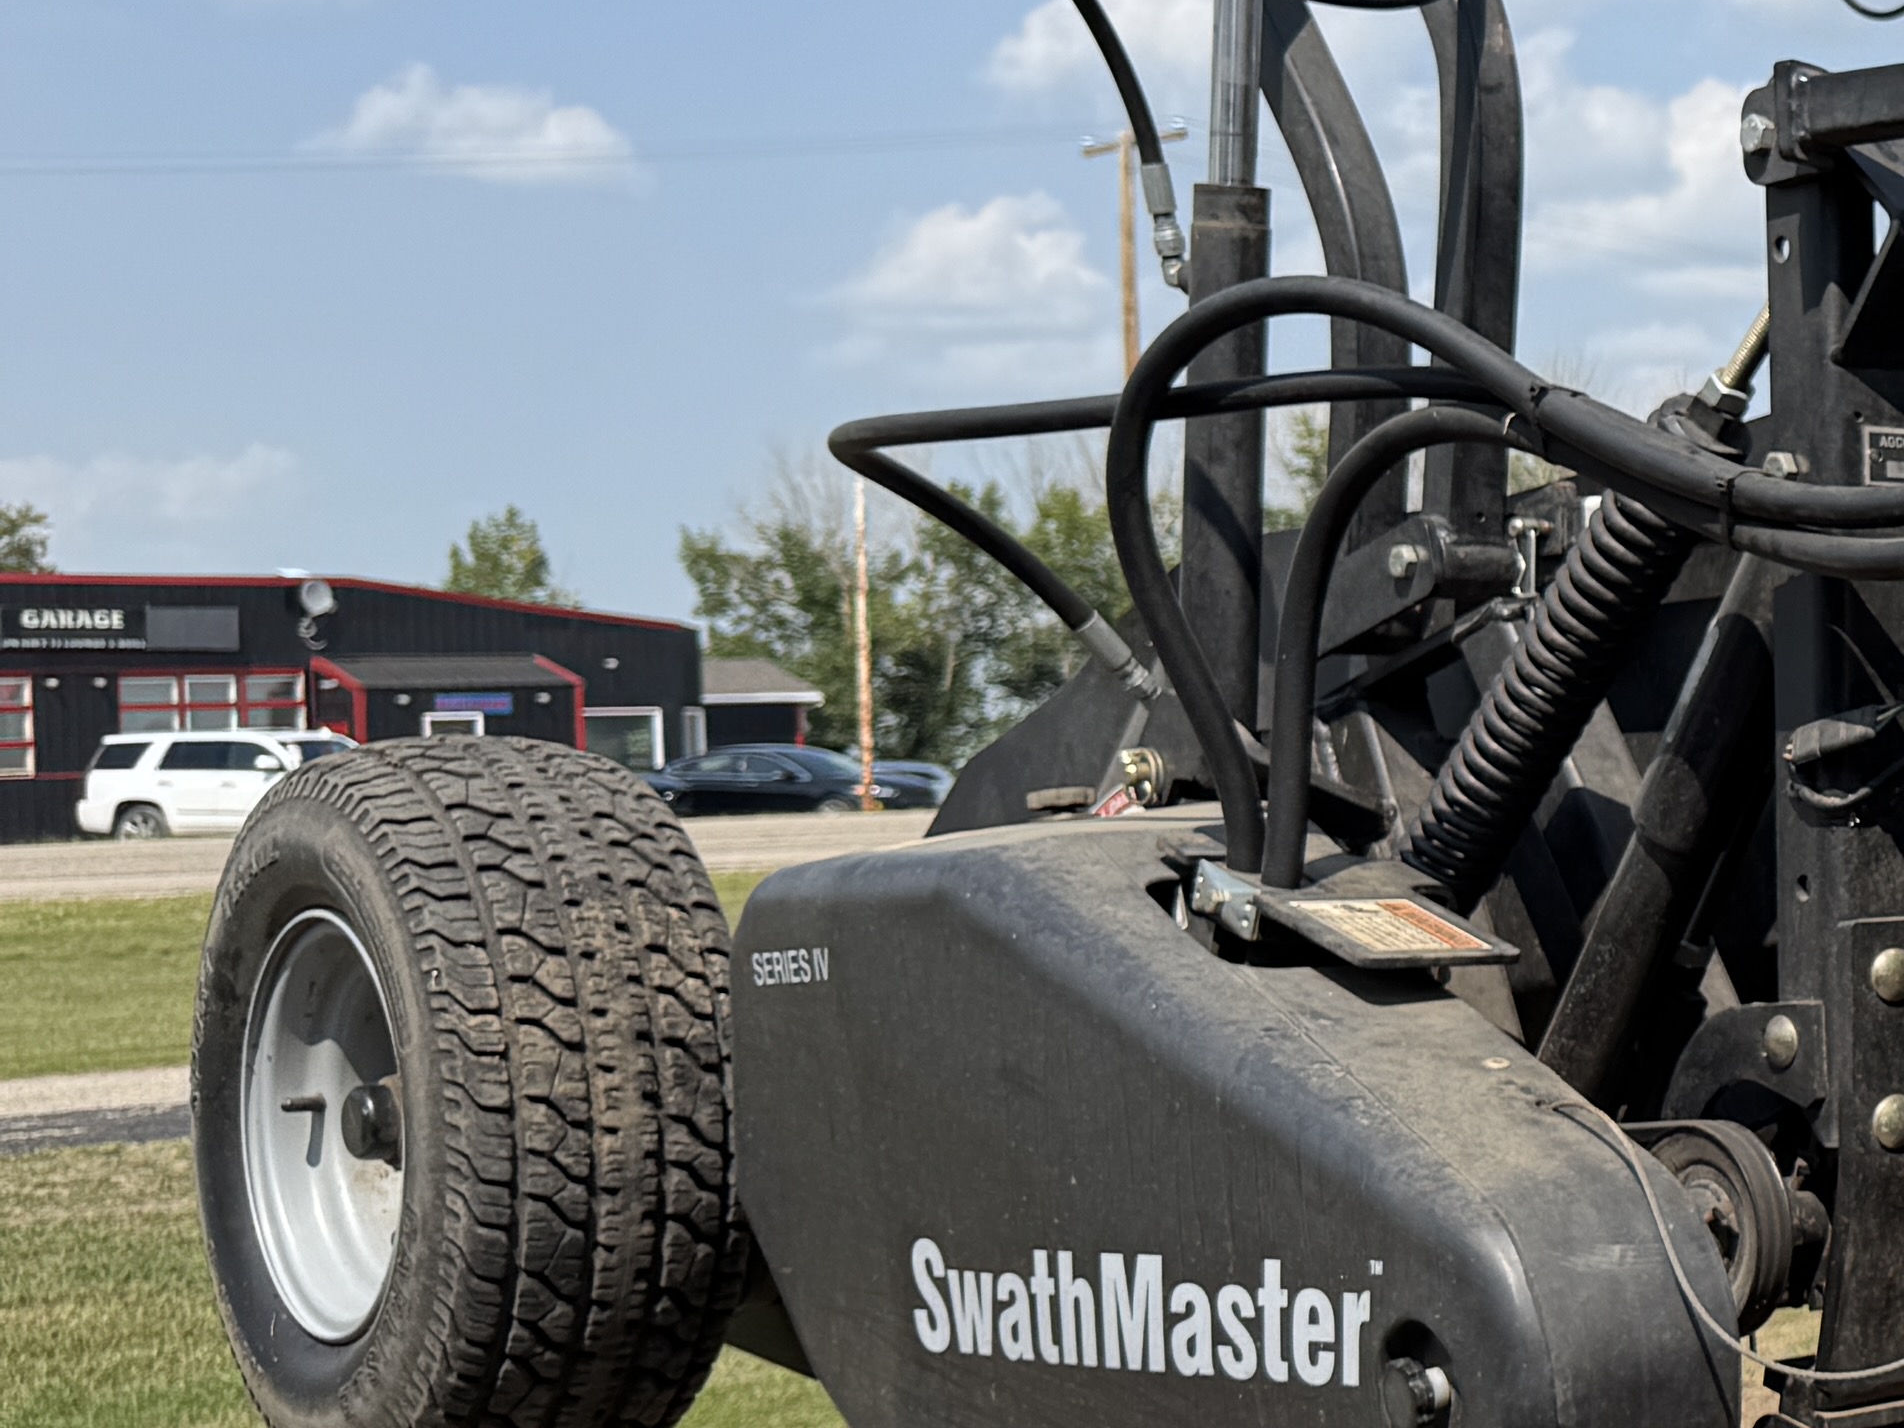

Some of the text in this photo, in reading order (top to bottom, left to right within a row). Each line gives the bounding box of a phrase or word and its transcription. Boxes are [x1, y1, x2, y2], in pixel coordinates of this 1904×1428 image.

[20, 608, 125, 630] GARAGE
[752, 947, 829, 987] SERIES IV
[911, 1237, 1372, 1388] SwathMaster
